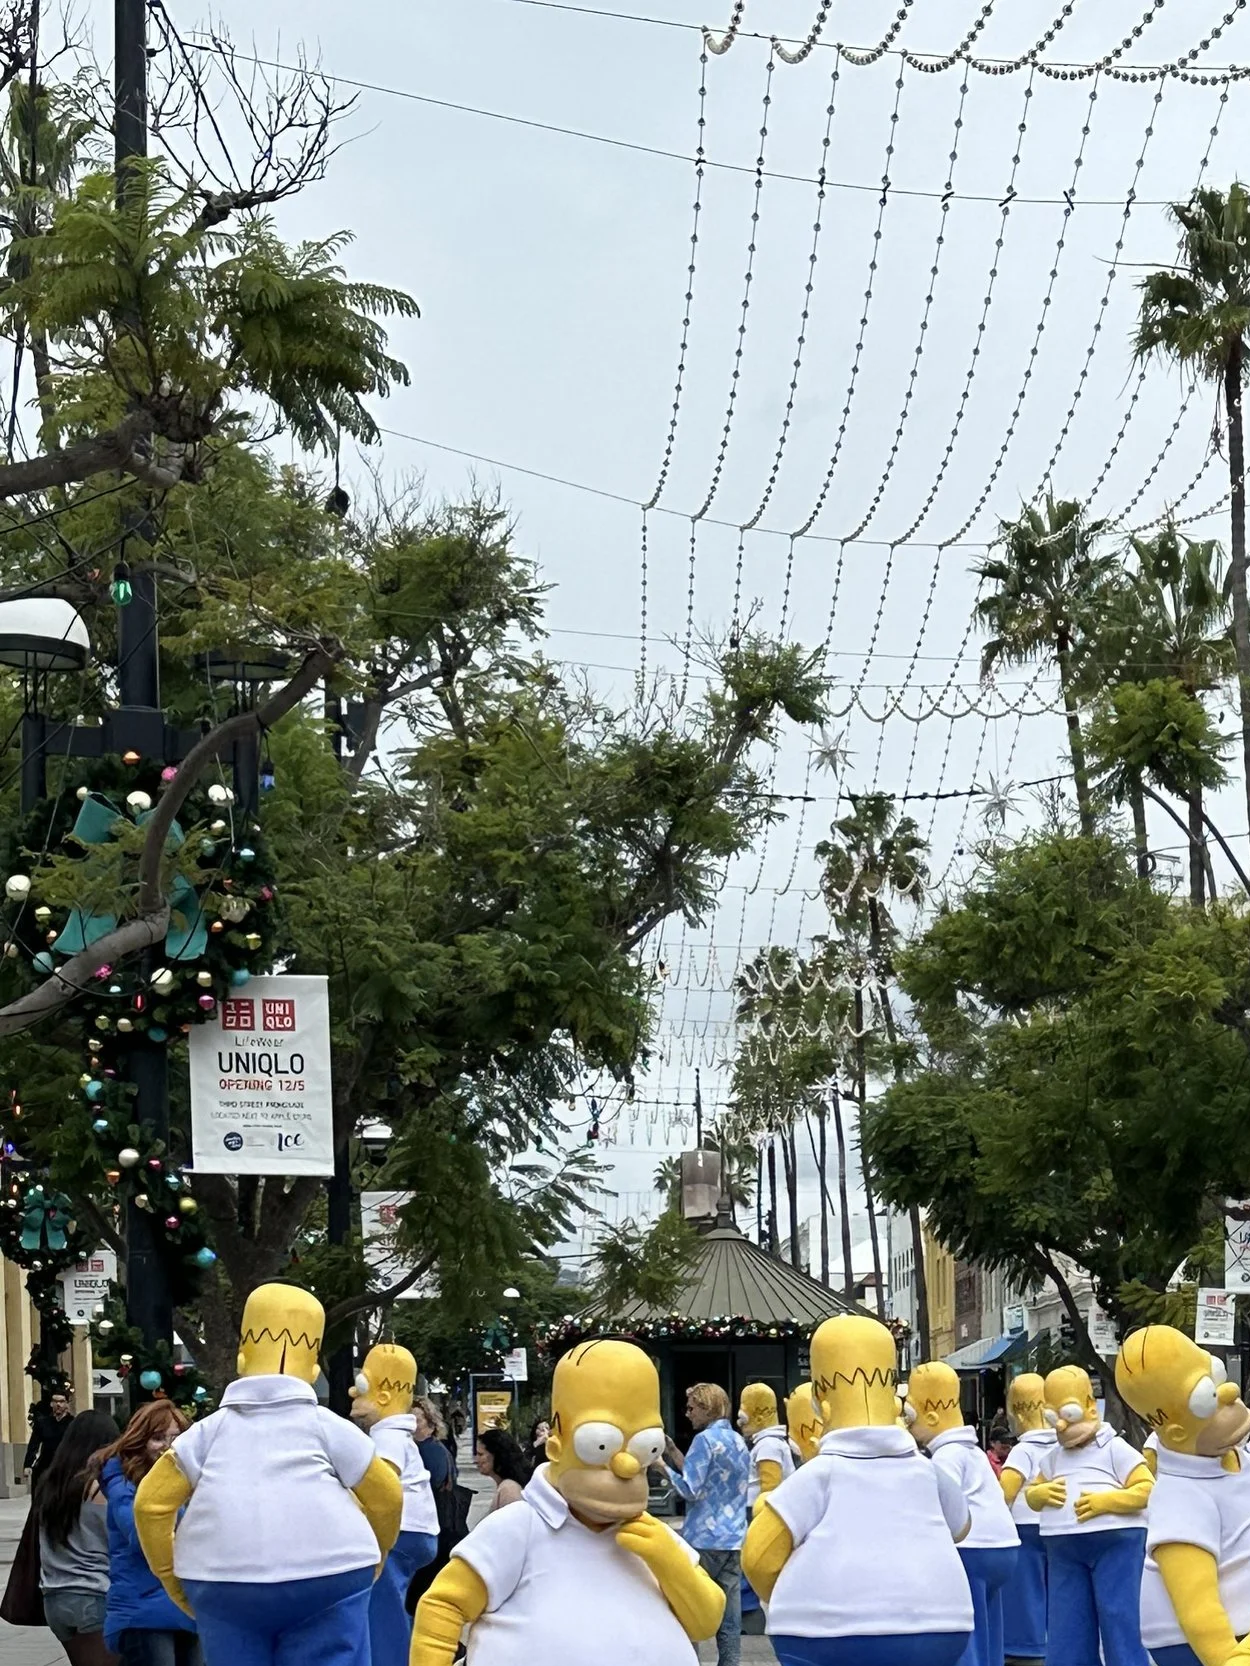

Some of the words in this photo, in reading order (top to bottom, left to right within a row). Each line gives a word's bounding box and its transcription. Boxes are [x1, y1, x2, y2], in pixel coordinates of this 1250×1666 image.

[265, 1003, 289, 1015] UNI
[266, 1016, 292, 1029] QLO
[218, 1052, 304, 1077] UNIQLO
[219, 1079, 272, 1091] OPENING
[278, 1079, 305, 1091] 12/5
